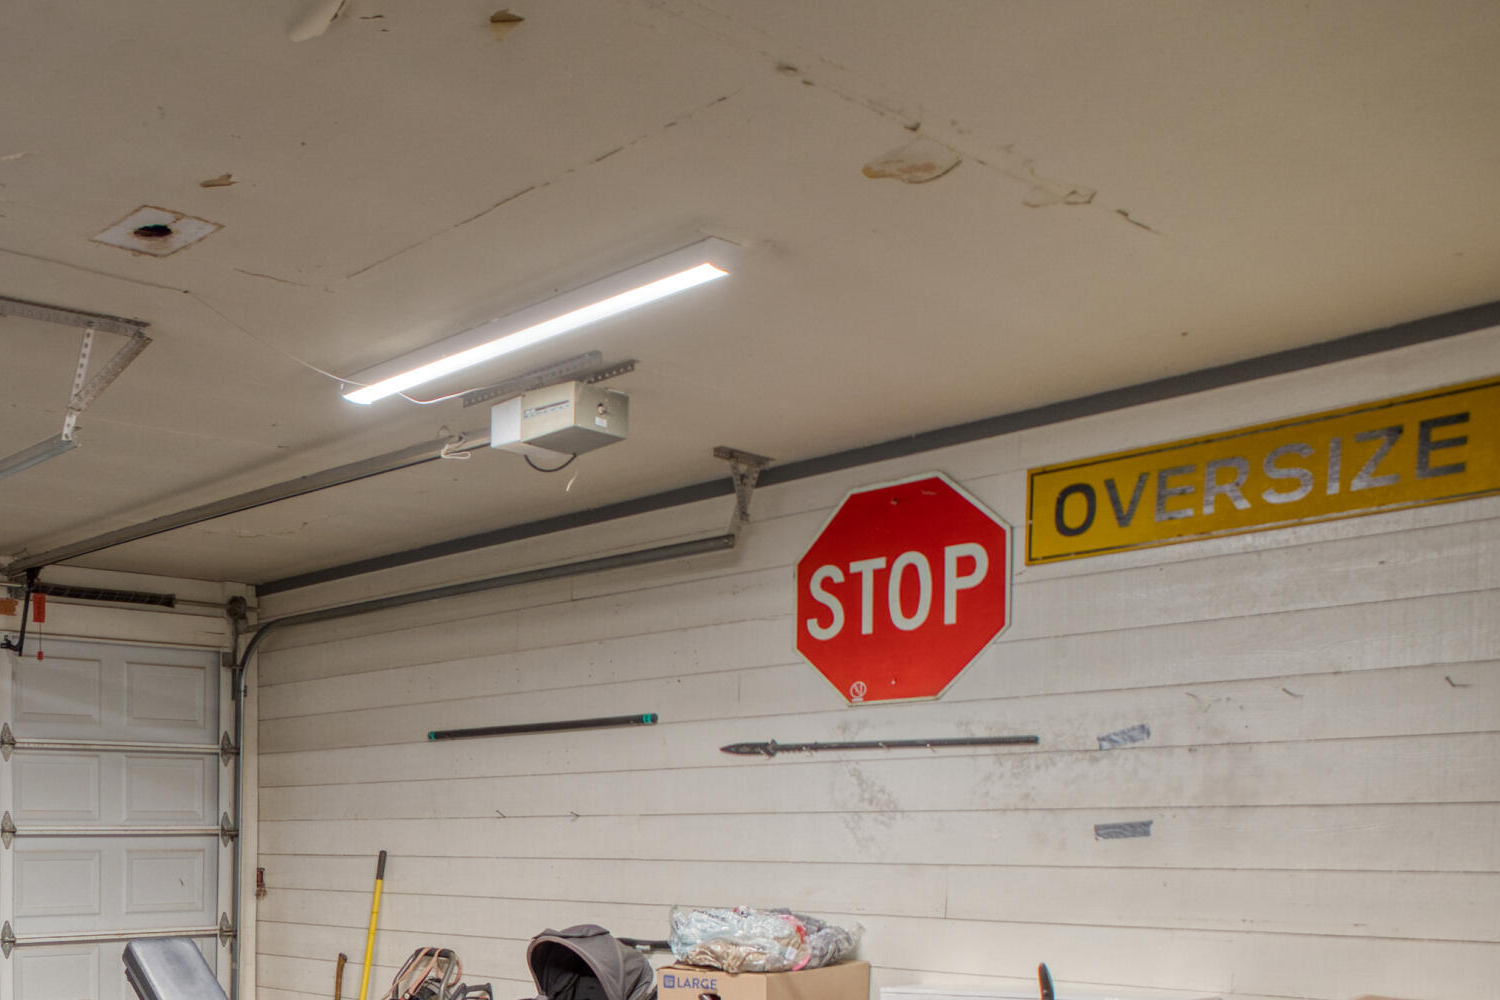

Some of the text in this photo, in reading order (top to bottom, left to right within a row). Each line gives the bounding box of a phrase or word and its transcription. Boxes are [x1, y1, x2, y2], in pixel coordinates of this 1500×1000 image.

[1054, 411, 1470, 537] OVERSIZE
[806, 542, 989, 641] STOP
[677, 976, 718, 990] LARGE
